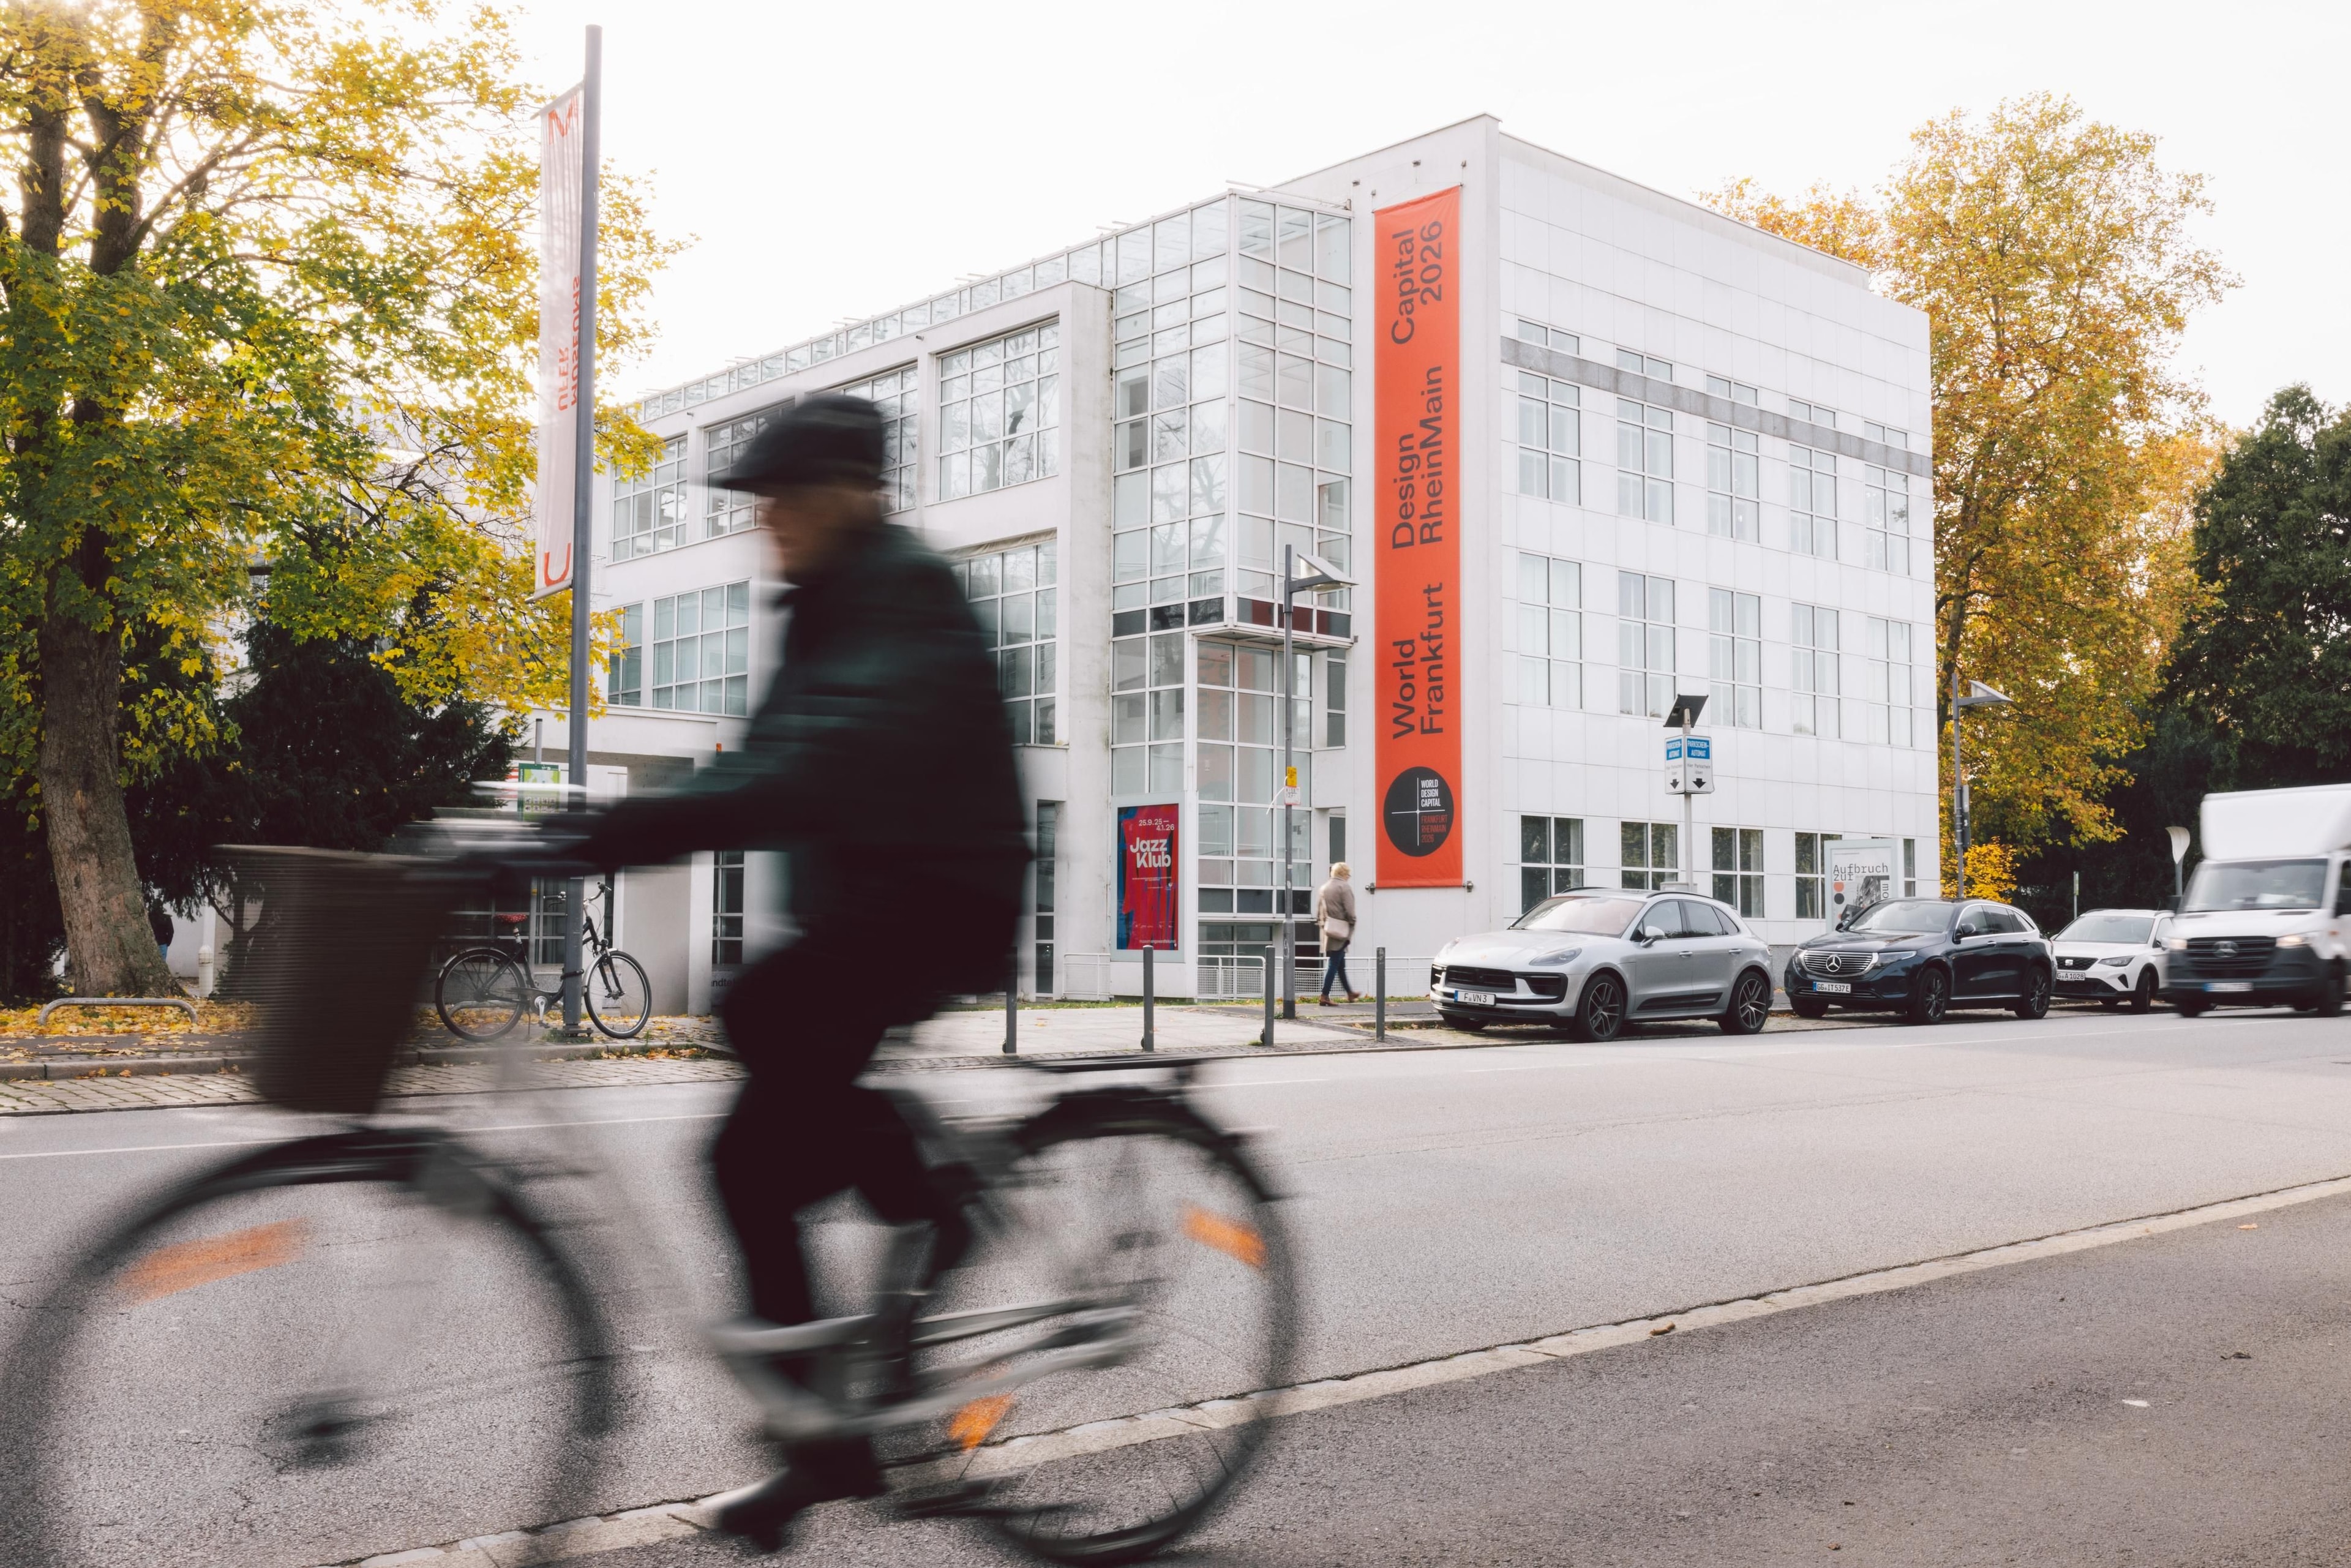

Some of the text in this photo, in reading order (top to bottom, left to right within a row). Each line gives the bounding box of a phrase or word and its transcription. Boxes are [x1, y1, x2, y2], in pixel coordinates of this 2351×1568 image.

[1419, 220, 1444, 735] Frankfurt RheinMain 2026
[1391, 228, 1420, 740] World Design Capital
[1421, 779, 1438, 789] WORLD
[1421, 789, 1438, 798] DESIGN
[1421, 798, 1441, 808] CAPITAL
[1421, 814, 1447, 823] FRANKFURT
[1130, 837, 1168, 853] Jazz
[1136, 851, 1171, 868] Klub
[1833, 862, 1888, 874] Aufbruch
